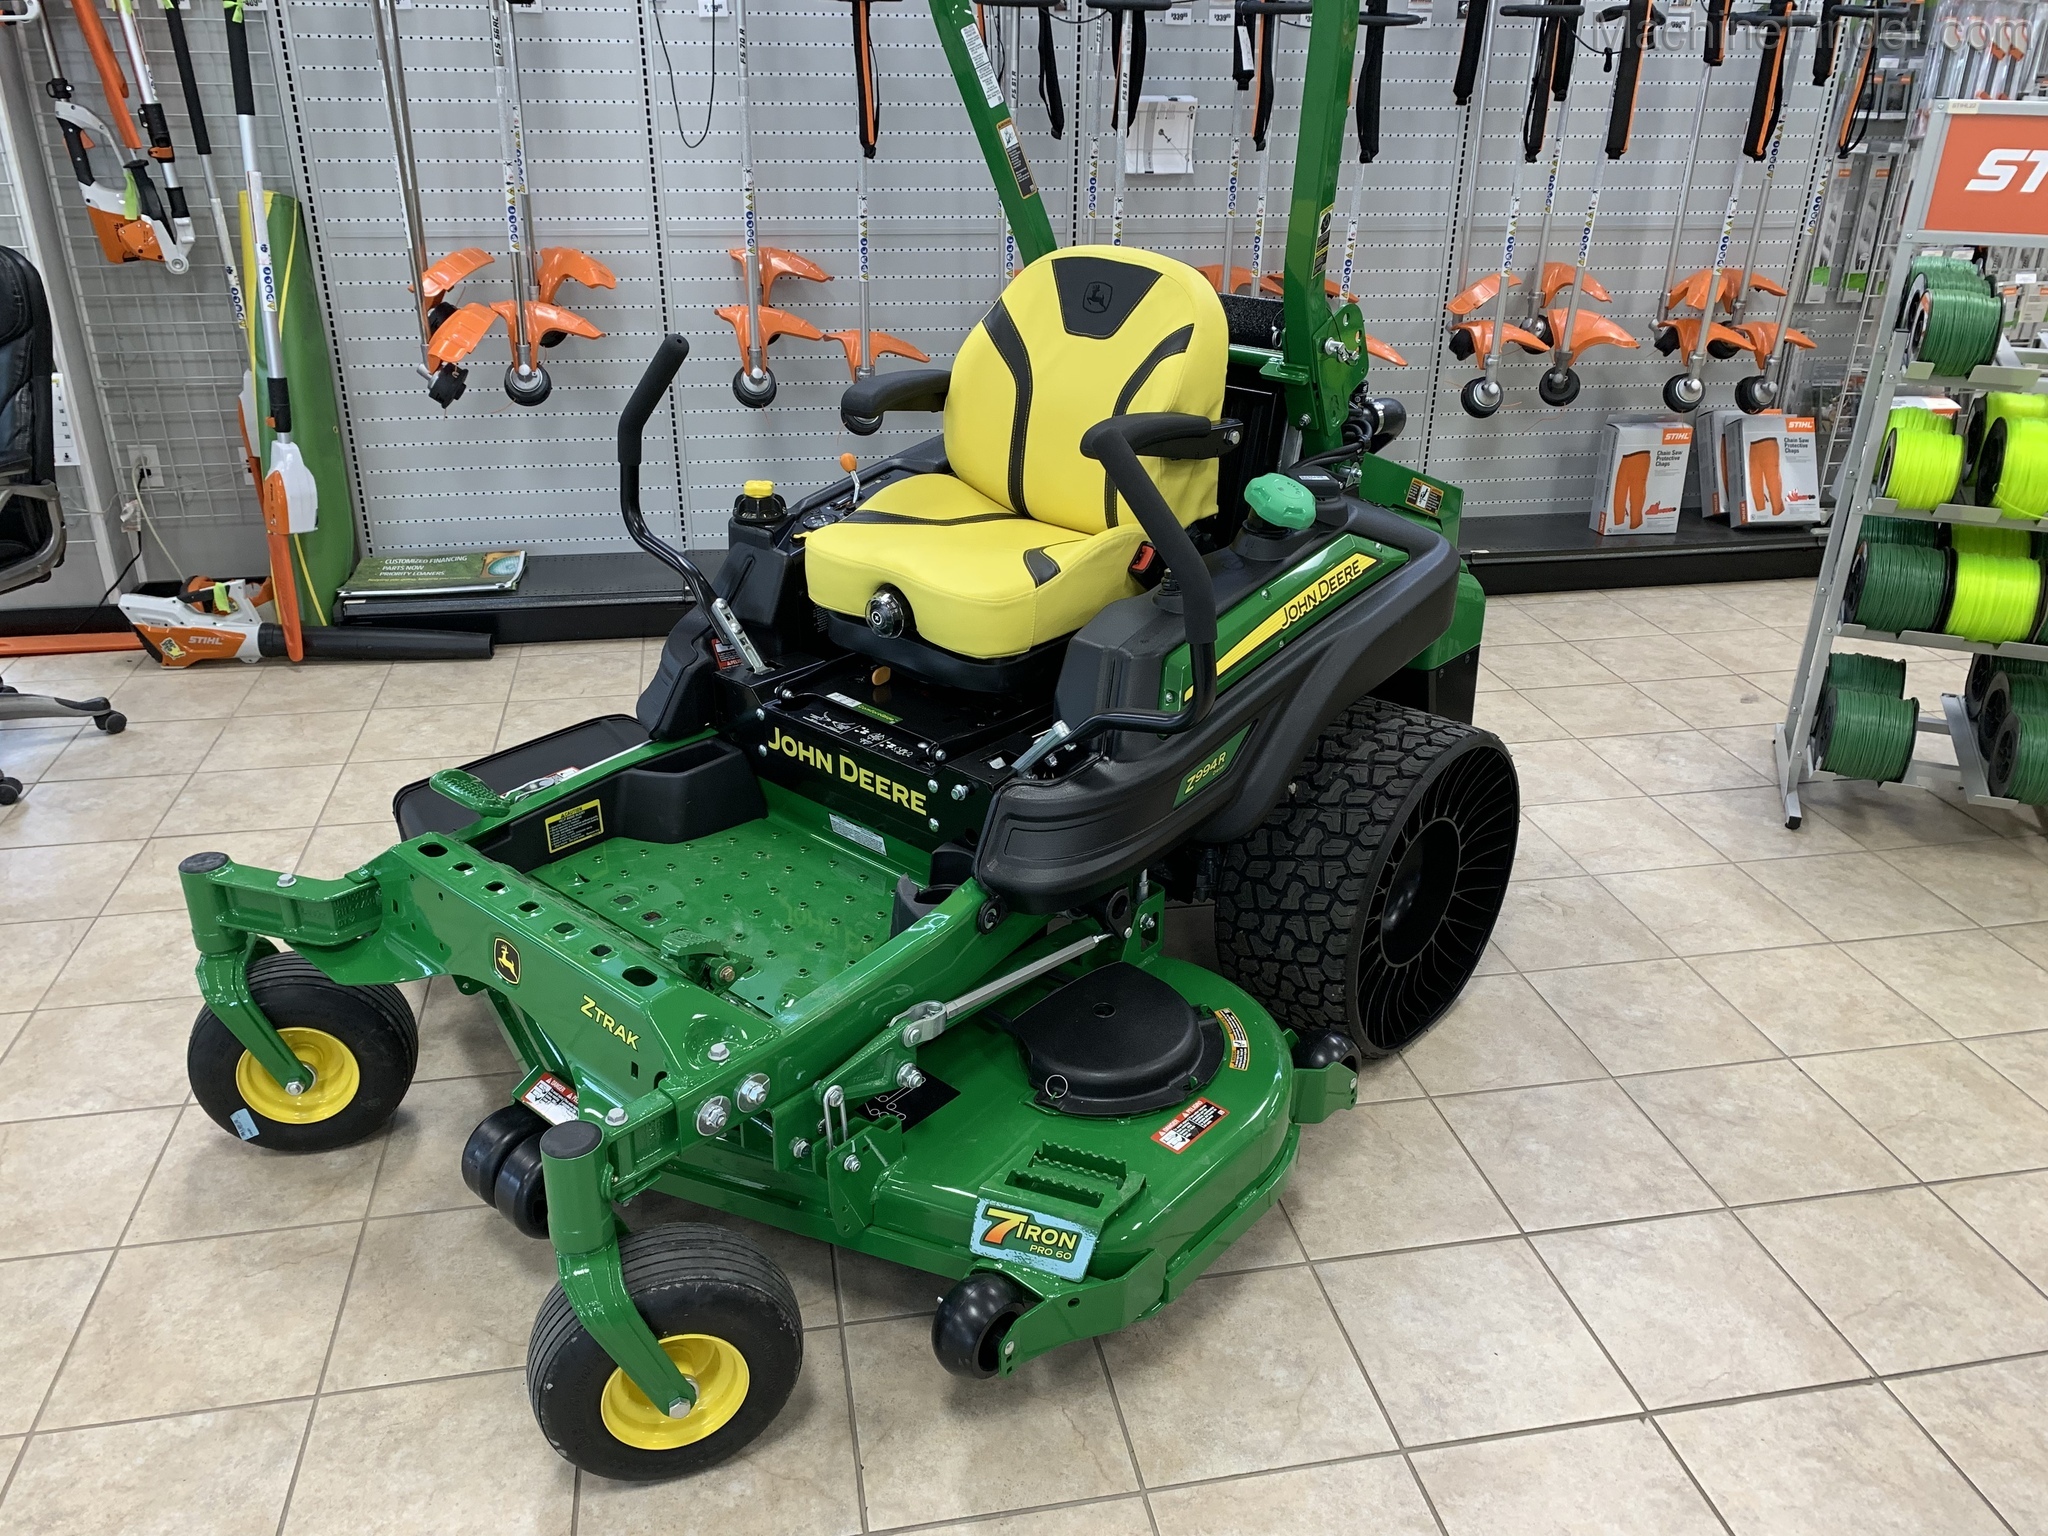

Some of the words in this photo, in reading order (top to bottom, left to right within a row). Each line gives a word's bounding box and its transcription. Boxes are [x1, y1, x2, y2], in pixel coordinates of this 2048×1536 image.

[1664, 432, 1690, 440] STIHL
[429, 555, 468, 564] FINANCING
[1282, 590, 1318, 627] JOHN
[1318, 560, 1361, 600] DEERE
[188, 636, 223, 645] STIHL
[768, 727, 833, 774] JOHN
[839, 754, 927, 816] DEERE
[1184, 752, 1227, 794] Z994R
[580, 994, 640, 1050] ZTRAK
[550, 1080, 566, 1092] DANGER
[984, 1207, 1029, 1244] 7
[1016, 1222, 1078, 1250] IRON
[1030, 1244, 1053, 1256] PRO
[1056, 1250, 1072, 1260] 60
